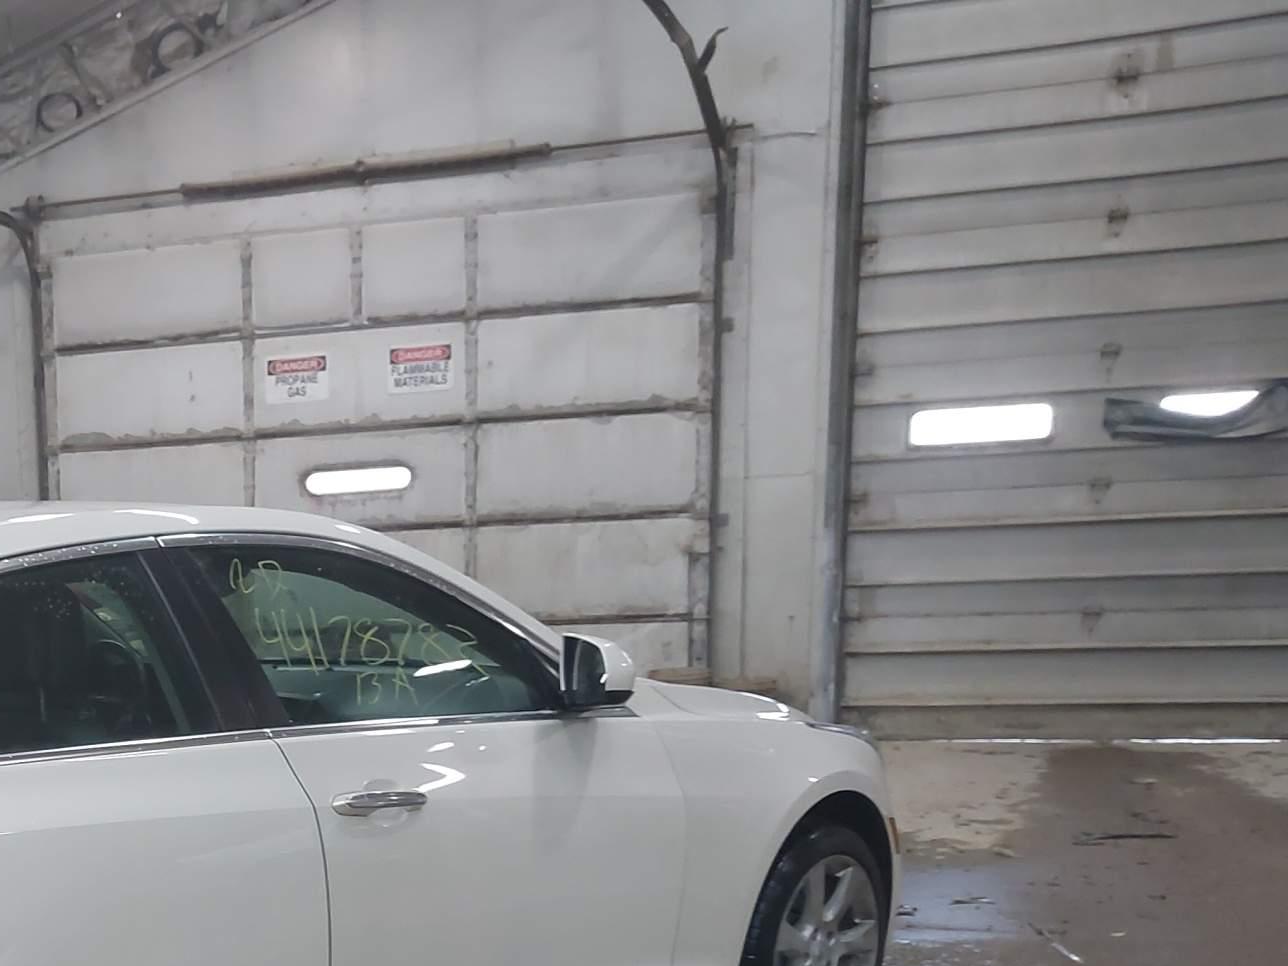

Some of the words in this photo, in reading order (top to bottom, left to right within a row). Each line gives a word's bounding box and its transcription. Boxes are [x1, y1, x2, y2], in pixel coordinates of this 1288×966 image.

[398, 348, 443, 361] DANGER
[274, 359, 319, 373] DANGER
[391, 360, 449, 376] FLAMMABLE
[275, 373, 318, 386] PROPANE
[394, 373, 448, 387] MATERIALS
[287, 385, 307, 398] GAS
